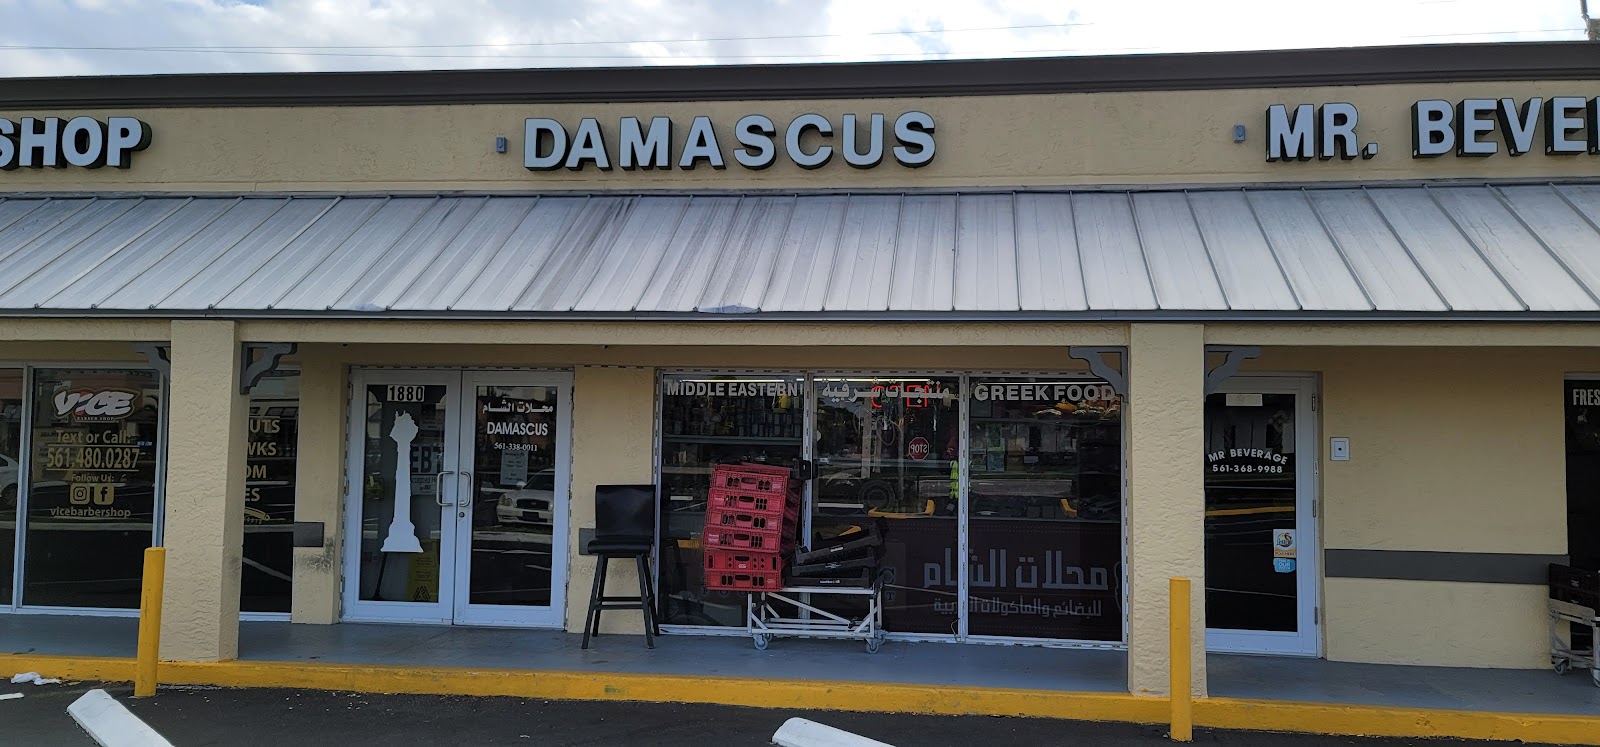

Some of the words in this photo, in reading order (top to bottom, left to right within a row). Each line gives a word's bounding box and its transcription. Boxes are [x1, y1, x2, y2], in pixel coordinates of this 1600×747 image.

[1266, 103, 1379, 162] MR.
[1411, 96, 1600, 158] BEVE
[523, 111, 937, 171] DAMASCUS
[389, 386, 424, 401] 1880
[667, 382, 725, 397] MIDDLE
[729, 382, 797, 397] EASTERN
[821, 377, 881, 404] شرقية
[886, 380, 951, 404] منتجات
[974, 385, 1050, 401] GREEK
[1054, 385, 1116, 401] FOOD
[1572, 389, 1600, 406] FRES
[54, 391, 134, 416] VICE
[482, 399, 515, 415] الشام
[516, 401, 554, 414] محلات
[249, 419, 281, 434] UTS
[487, 421, 549, 436] DAMASCUS
[56, 430, 83, 444] Text
[86, 433, 101, 444] or
[494, 442, 539, 452] 561-338-0011
[46, 447, 141, 469] 561.480.0287
[1208, 450, 1225, 463] MR
[1230, 448, 1288, 465] BEVERAGE
[1212, 464, 1283, 474] 561-368-9988
[71, 474, 99, 482] Follow
[101, 474, 115, 482] Us:
[50, 506, 132, 518] vicebarbershop
[923, 547, 1007, 589] الشام
[1015, 550, 1109, 591] محلات
